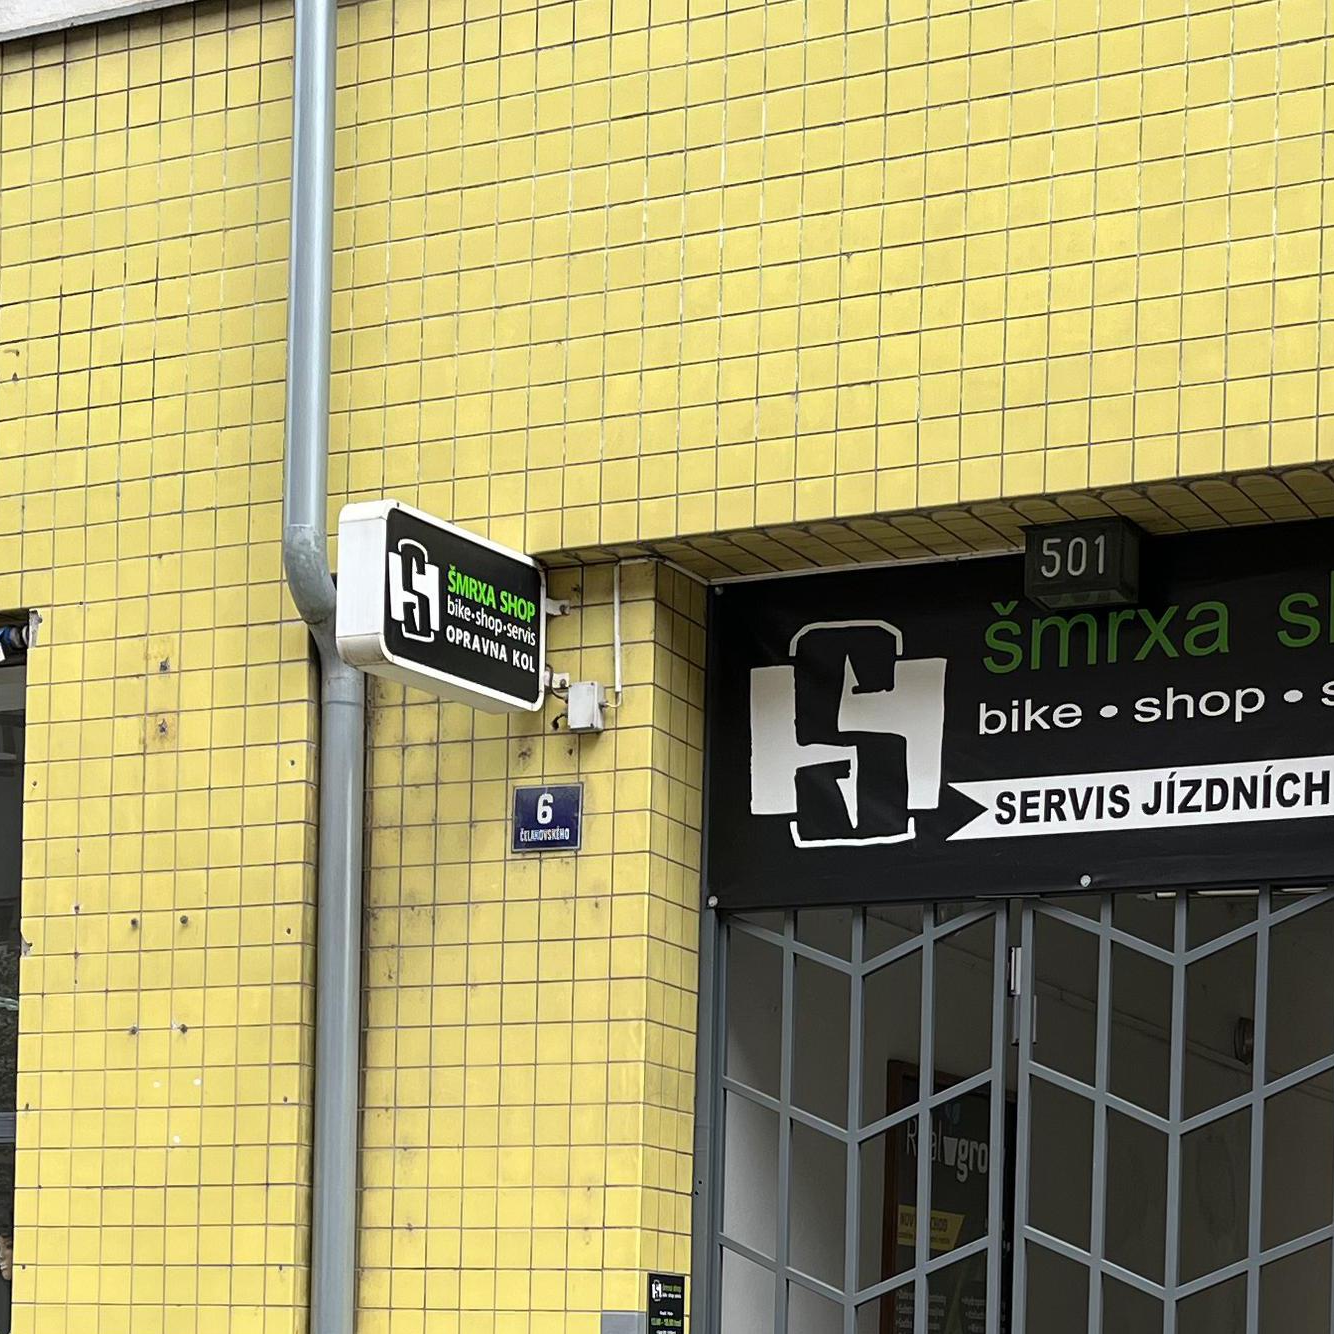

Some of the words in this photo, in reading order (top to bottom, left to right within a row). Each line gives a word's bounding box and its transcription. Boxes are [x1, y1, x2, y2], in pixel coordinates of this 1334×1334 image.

[1040, 534, 1106, 578] 501
[447, 564, 497, 610] ŠMRXA
[500, 589, 536, 624] SHOP
[446, 625, 508, 663] OPRAVNA
[512, 648, 536, 673] KOL
[982, 600, 1231, 674] šmrxa
[978, 698, 1083, 735] bike
[1134, 686, 1266, 722] shop
[536, 793, 554, 825] 6
[994, 784, 1131, 826] SERVIS
[1141, 765, 1331, 816] JÍZDNÍCH
[519, 825, 570, 842] ČELAKOVSKÉHO
